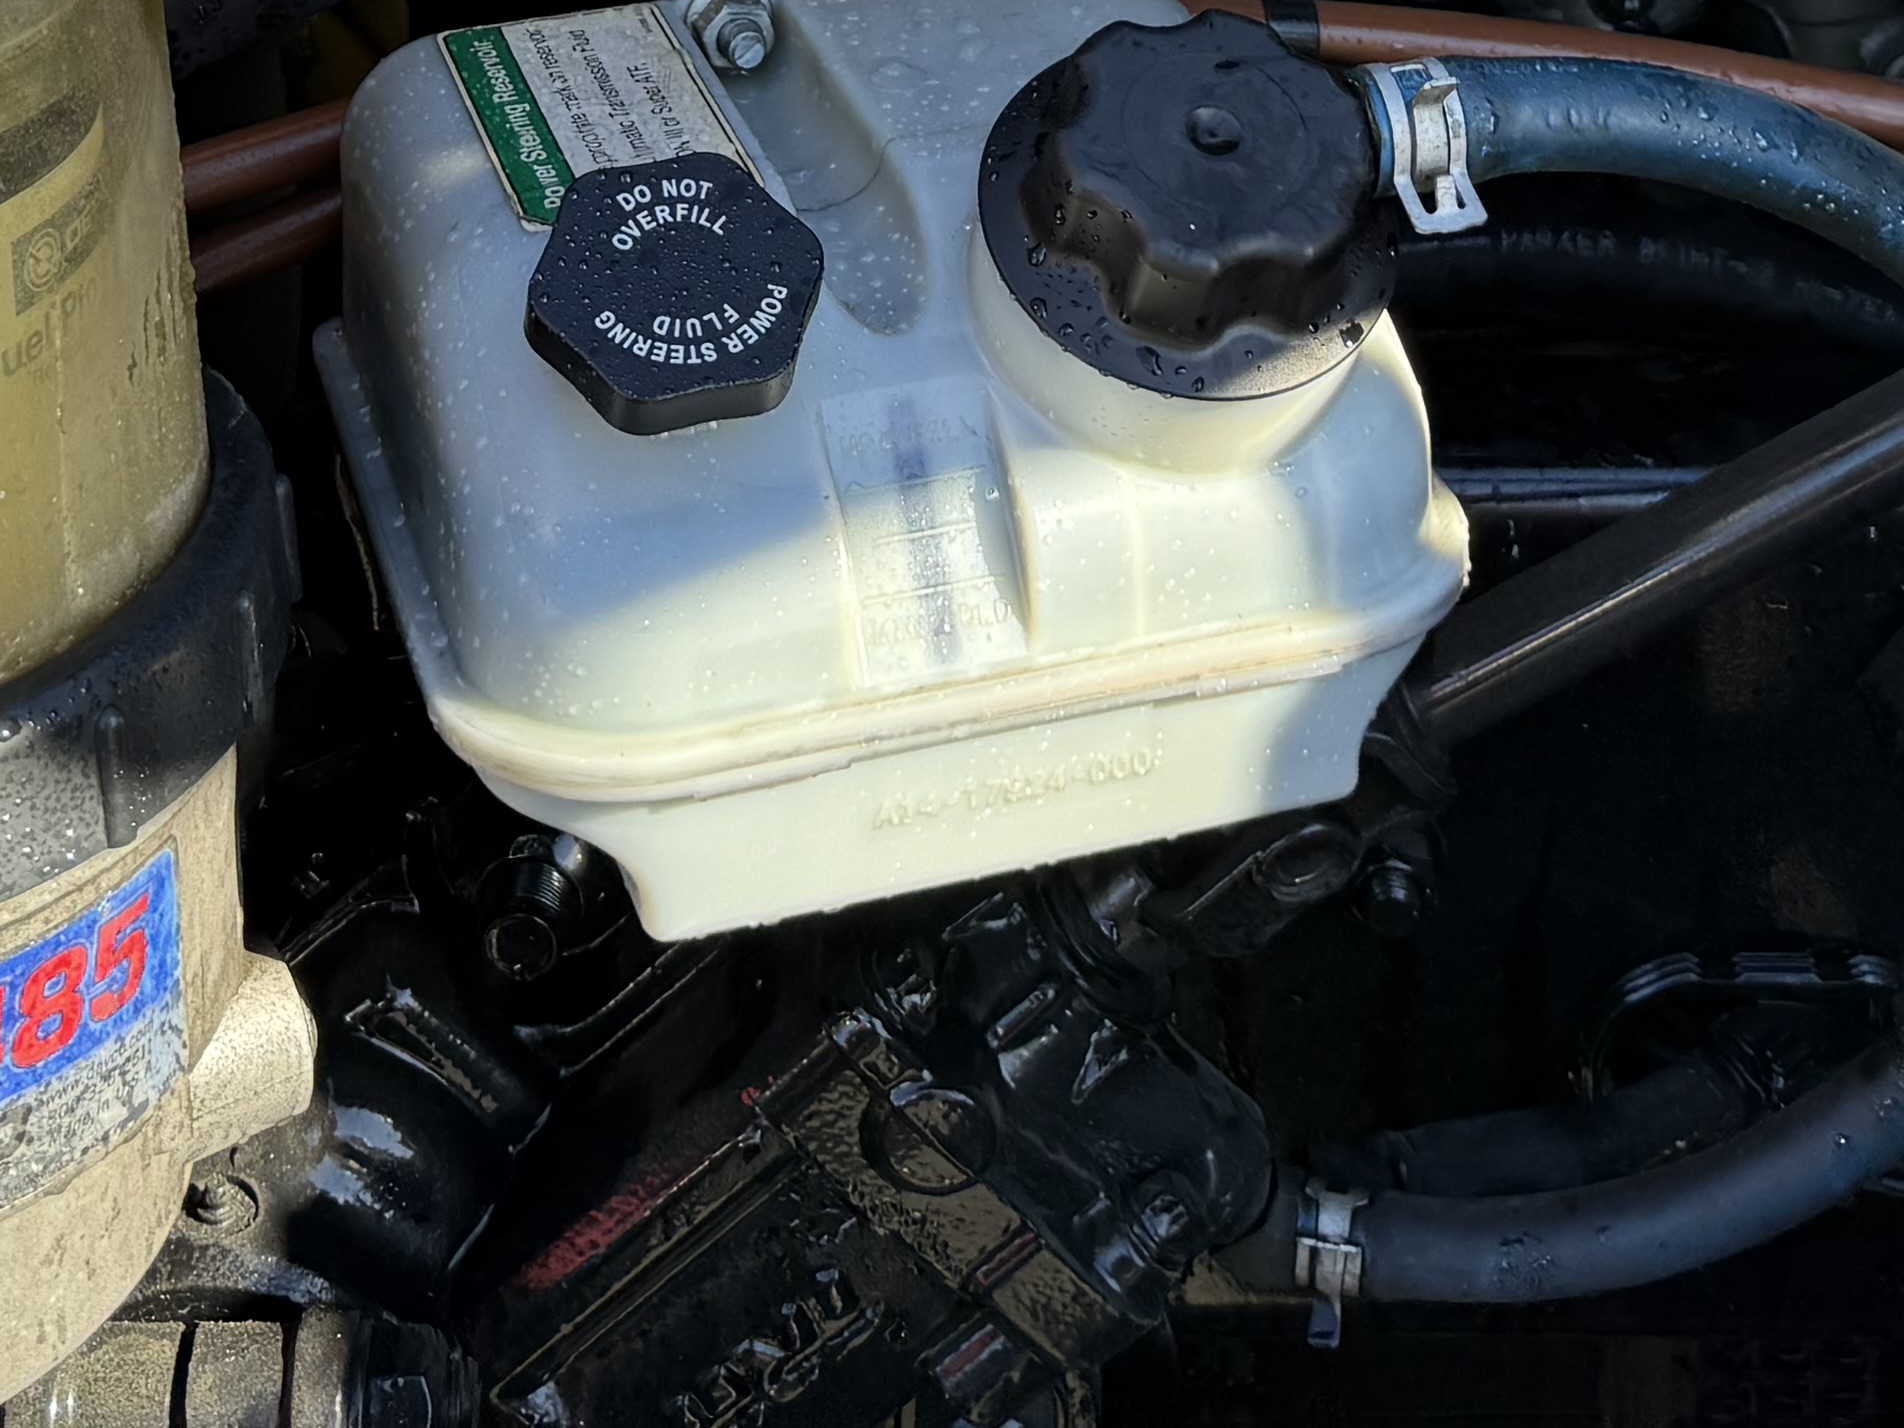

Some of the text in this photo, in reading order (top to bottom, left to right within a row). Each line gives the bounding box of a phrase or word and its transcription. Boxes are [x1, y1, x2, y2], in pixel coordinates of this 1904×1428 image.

[471, 40, 520, 104] Reservoir
[504, 103, 548, 164] Steering
[616, 178, 713, 212] DO NOT
[612, 203, 727, 250] OVERFILL
[594, 283, 788, 365] POWER STEERING
[652, 303, 740, 338] FLUID
